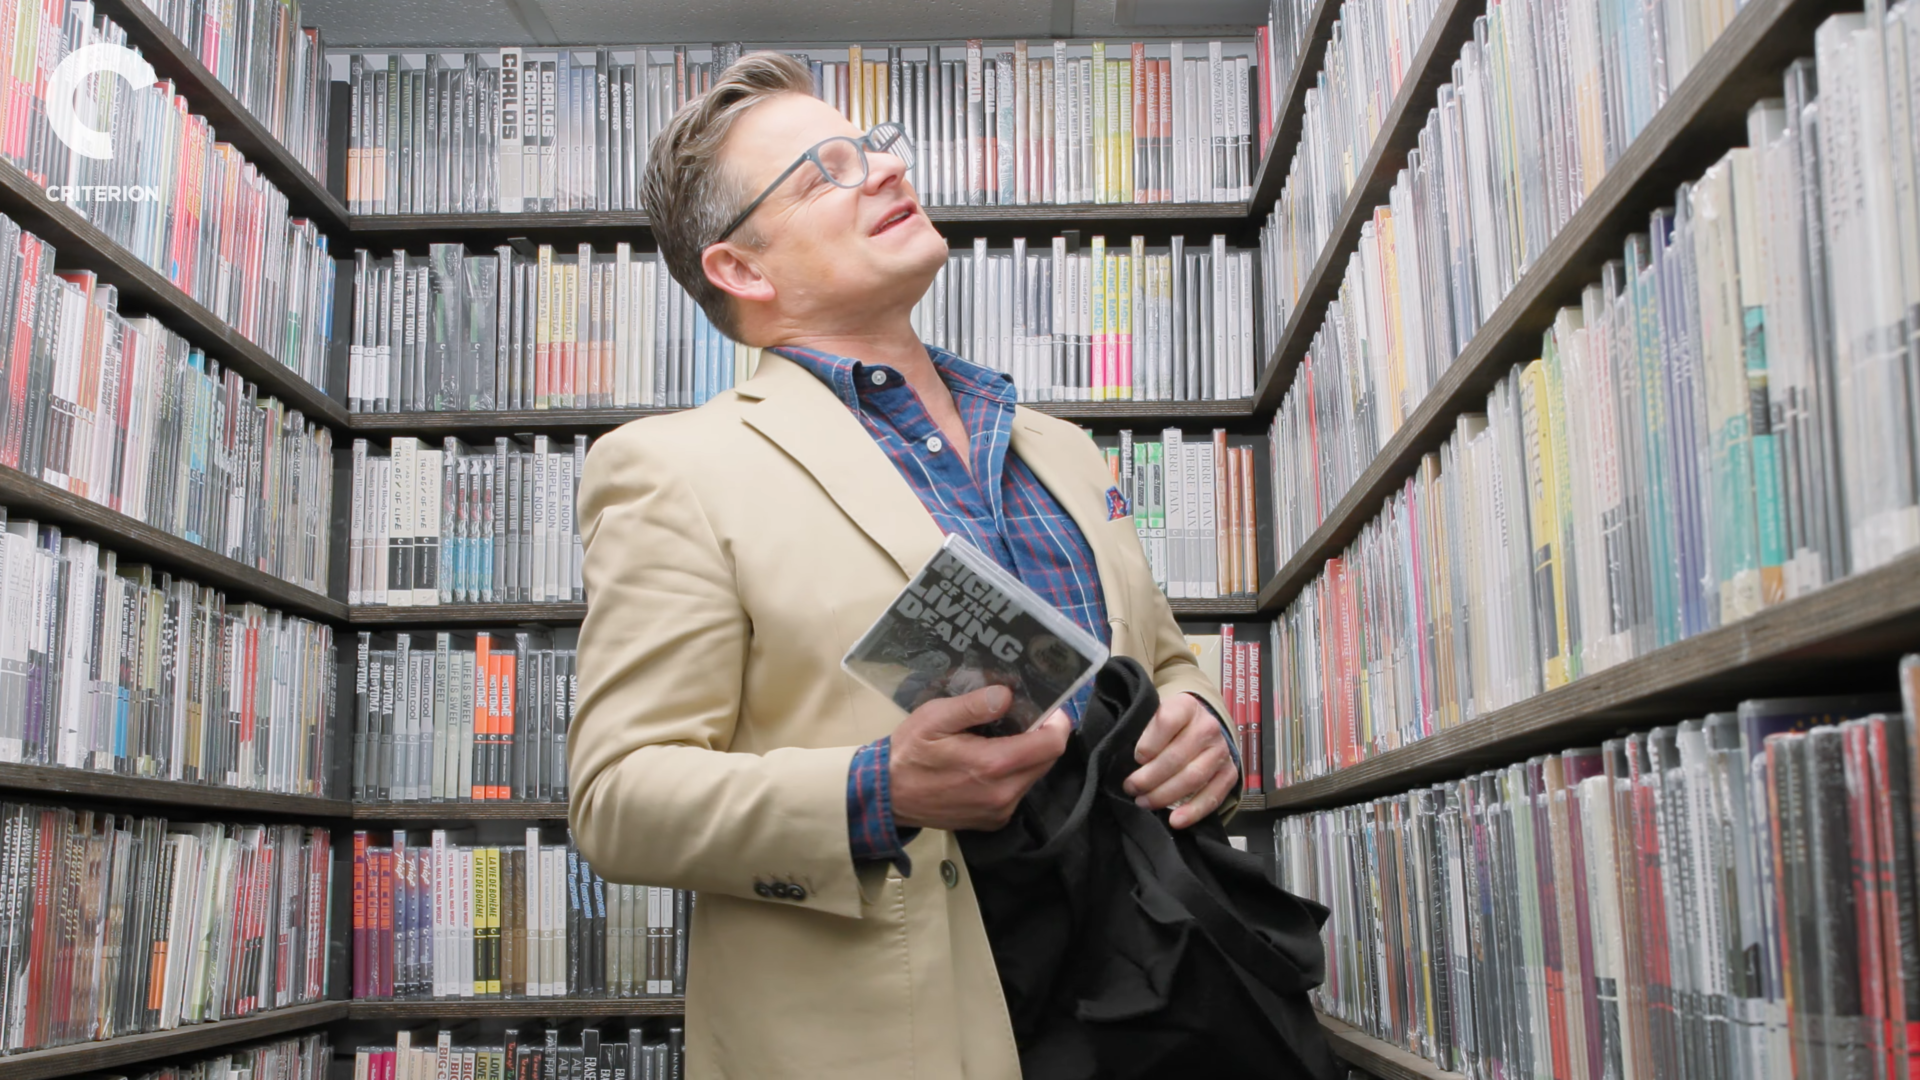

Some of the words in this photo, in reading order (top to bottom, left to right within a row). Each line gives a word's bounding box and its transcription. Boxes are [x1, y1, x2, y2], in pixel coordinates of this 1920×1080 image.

[968, 49, 981, 102] GODZILLA
[1122, 65, 1130, 84] TINY
[502, 54, 517, 139] CARLOS
[524, 70, 537, 136] CARLOS
[598, 74, 607, 120] KURONEKO
[984, 69, 995, 113] GODZILLA
[611, 84, 619, 130] KURONEKO
[1121, 86, 1131, 132] FURNITURE
[418, 273, 426, 288] THE
[1093, 247, 1103, 287] EATING
[406, 275, 414, 292] THE
[20, 280, 30, 323] SOLDIER
[27, 285, 37, 328] SOLDIER
[406, 295, 414, 315] WAR
[418, 292, 426, 313] WAR
[1093, 294, 1103, 330] RAOUL
[1108, 299, 1116, 328] RAOUL
[405, 318, 414, 345] ROOM
[418, 316, 426, 342] ROOM
[1168, 436, 1178, 476] PIERRE
[1186, 448, 1196, 488] PIERRE
[548, 458, 557, 497] PURPLE
[562, 461, 570, 501] PURPLE
[380, 490, 388, 511] Bloody
[420, 496, 427, 507] OF
[1170, 481, 1179, 514] ETAIX
[1187, 492, 1196, 527] ETAIX
[548, 502, 556, 528] NOON
[561, 505, 570, 532] NOON
[931, 552, 1026, 625] NIGHT
[939, 579, 961, 598] OF
[959, 594, 994, 625] THE
[896, 592, 973, 653] DEAD
[906, 570, 1024, 664] LIVING
[397, 642, 405, 679] medium
[438, 640, 446, 657] LIFE
[1223, 635, 1233, 661] TOUKI
[1249, 648, 1259, 674] TOUKI
[410, 661, 418, 698] medium
[437, 661, 446, 670] IS
[451, 663, 459, 681] LIFE
[1223, 663, 1232, 689] BOUKI
[368, 686, 380, 712] YUMA
[397, 682, 405, 701] cool
[437, 674, 445, 703] SWEET
[450, 684, 458, 693] IS
[556, 674, 567, 700] SAFETY
[1250, 676, 1259, 702] BOUKI
[409, 700, 417, 720] cool
[449, 697, 458, 726] SWEET
[501, 696, 511, 717] COME
[555, 701, 565, 720] LAST!
[10, 817, 19, 875] FIGHTING
[19, 817, 29, 874] FIGHTING
[33, 828, 41, 863] CASQUE
[65, 822, 74, 865] NIGHT
[69, 845, 78, 885] NIGHT
[395, 851, 405, 880] Thief
[476, 857, 483, 866] LA
[489, 857, 497, 866] LA
[489, 867, 497, 877] VIE
[6, 878, 16, 917] ELEGY
[16, 878, 25, 916] ELEGY
[476, 879, 483, 888] DE
[489, 879, 497, 888] DE
[60, 887, 69, 920] CITY
[476, 889, 485, 918] BOHÈME
[489, 889, 499, 917] BOHÈME
[65, 909, 73, 942] CITY
[478, 1056, 487, 1079] LOVE
